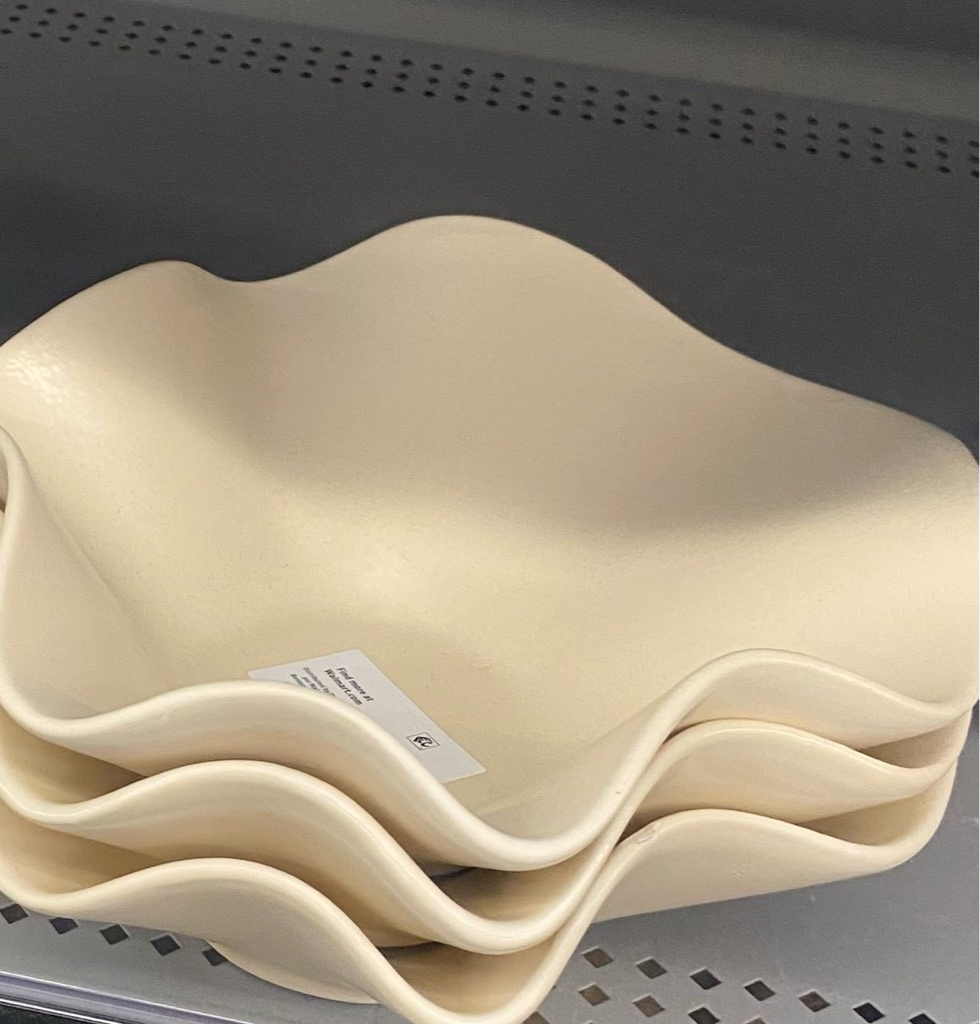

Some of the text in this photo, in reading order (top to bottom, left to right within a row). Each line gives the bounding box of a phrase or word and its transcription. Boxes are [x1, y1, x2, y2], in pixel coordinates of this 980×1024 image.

[324, 668, 363, 706] Walmart.com
[335, 667, 354, 680] Find
[348, 680, 367, 695] more
